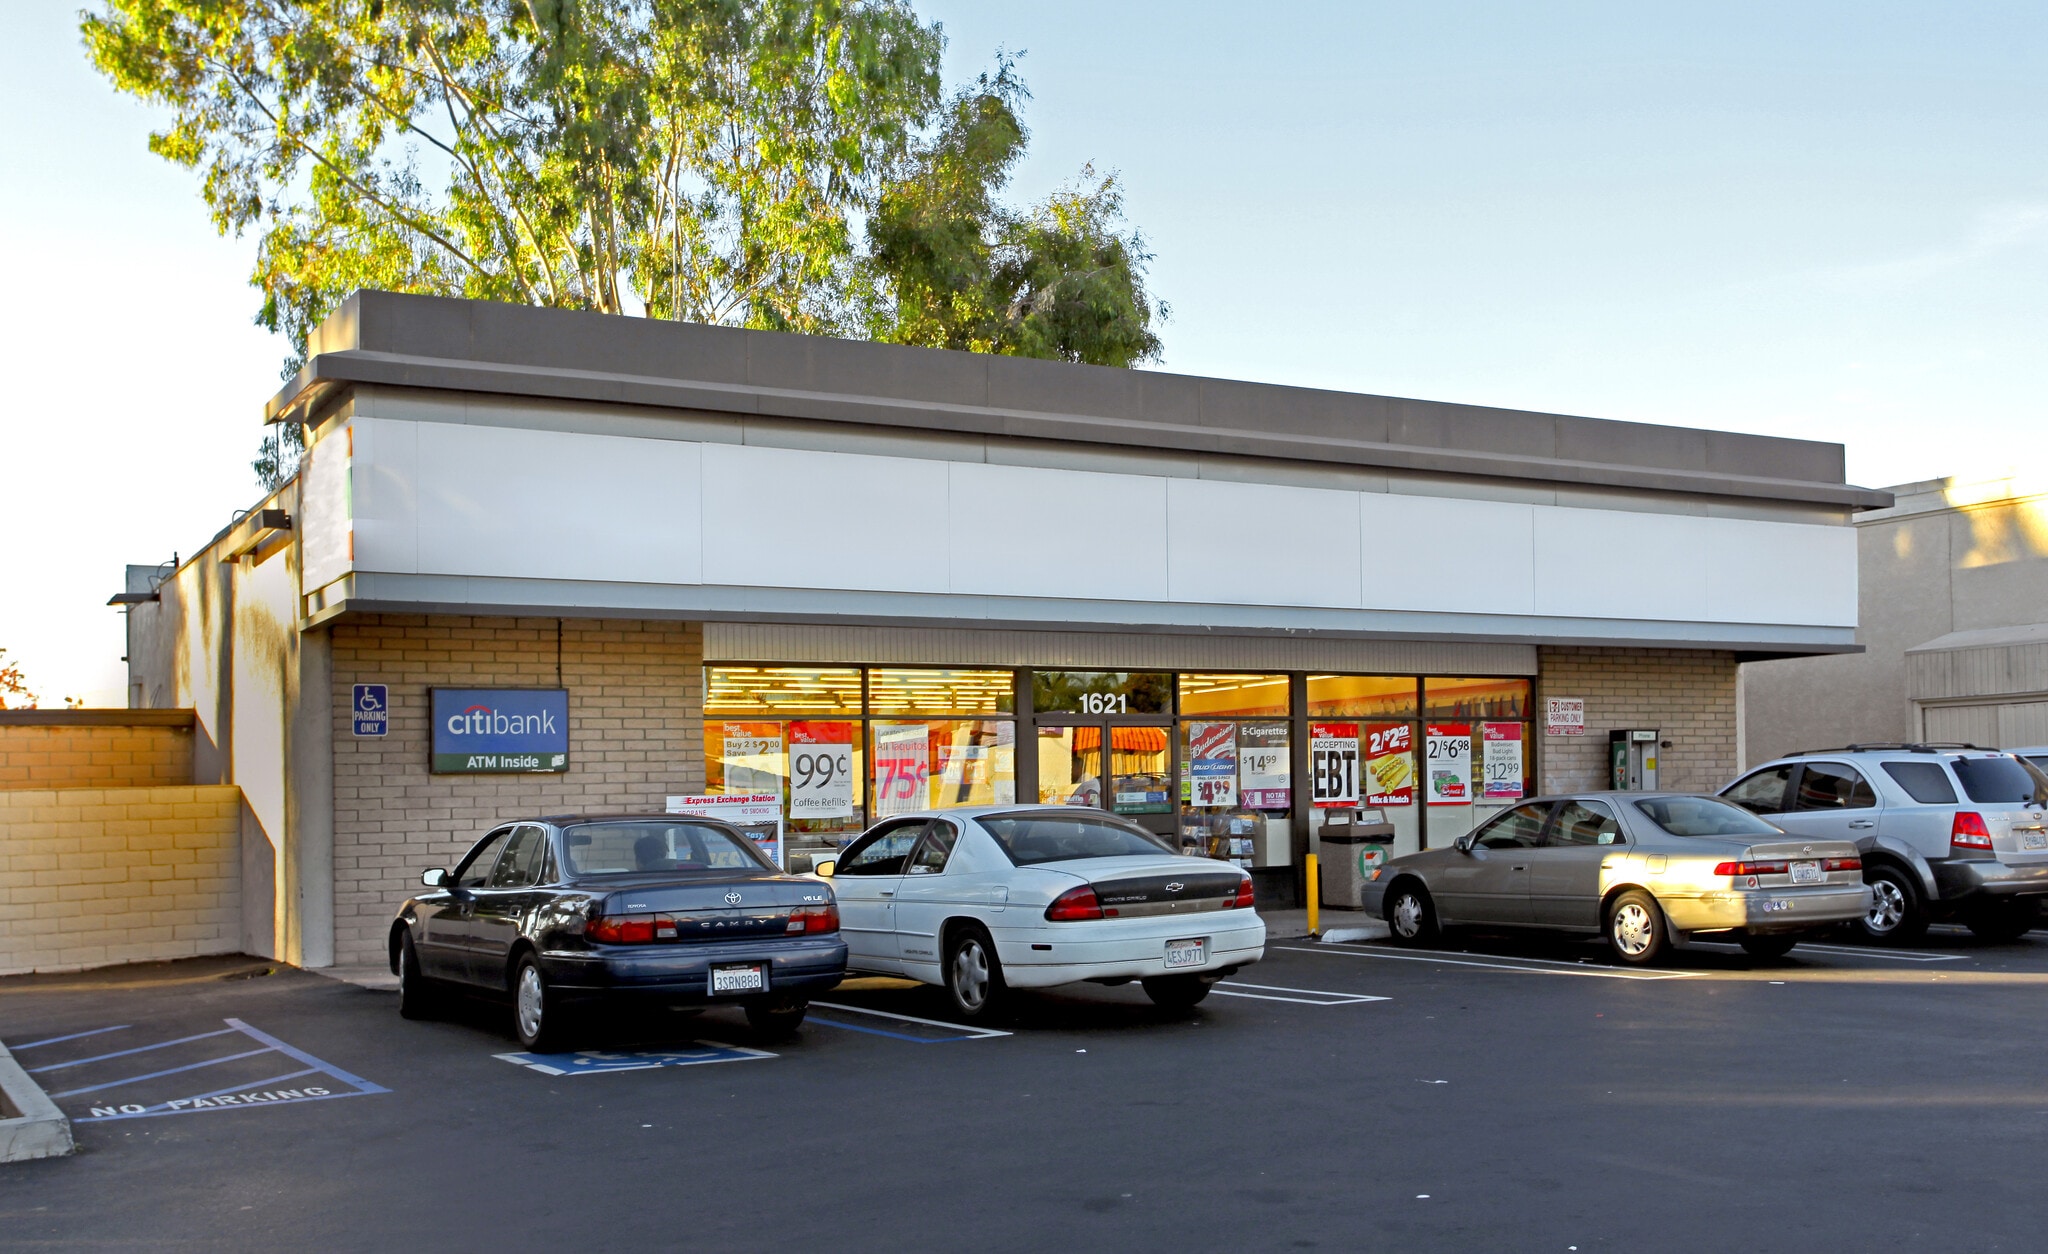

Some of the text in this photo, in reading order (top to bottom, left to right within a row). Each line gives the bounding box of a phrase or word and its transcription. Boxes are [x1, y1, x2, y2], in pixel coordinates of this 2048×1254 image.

[1079, 692, 1126, 714] 1621
[1561, 702, 1582, 711] CUSTOMER
[354, 710, 386, 721] PARKING
[1550, 713, 1581, 722] PARKING ONLY
[447, 707, 556, 735] citibank
[360, 722, 380, 733] ONLY
[724, 723, 741, 732] best
[1242, 727, 1288, 737] E-Cigarettes
[732, 729, 752, 738] value
[794, 731, 808, 739] best
[726, 741, 742, 749] Buy
[744, 740, 750, 748] 2
[877, 741, 927, 752] All Taquitos
[1313, 740, 1356, 749] ACCEPTING
[466, 754, 539, 768] ATM Inside
[795, 753, 848, 789] 99¢
[1313, 750, 1356, 798] EBT
[686, 795, 775, 806] Express Exchange Station
[793, 798, 820, 807] Coffee
[1369, 796, 1382, 804] Mix
[1389, 795, 1409, 803] Match
[701, 919, 767, 928] CAMRY
[716, 974, 760, 990] 3SRN888
[89, 1086, 331, 1117] NO PARKING
